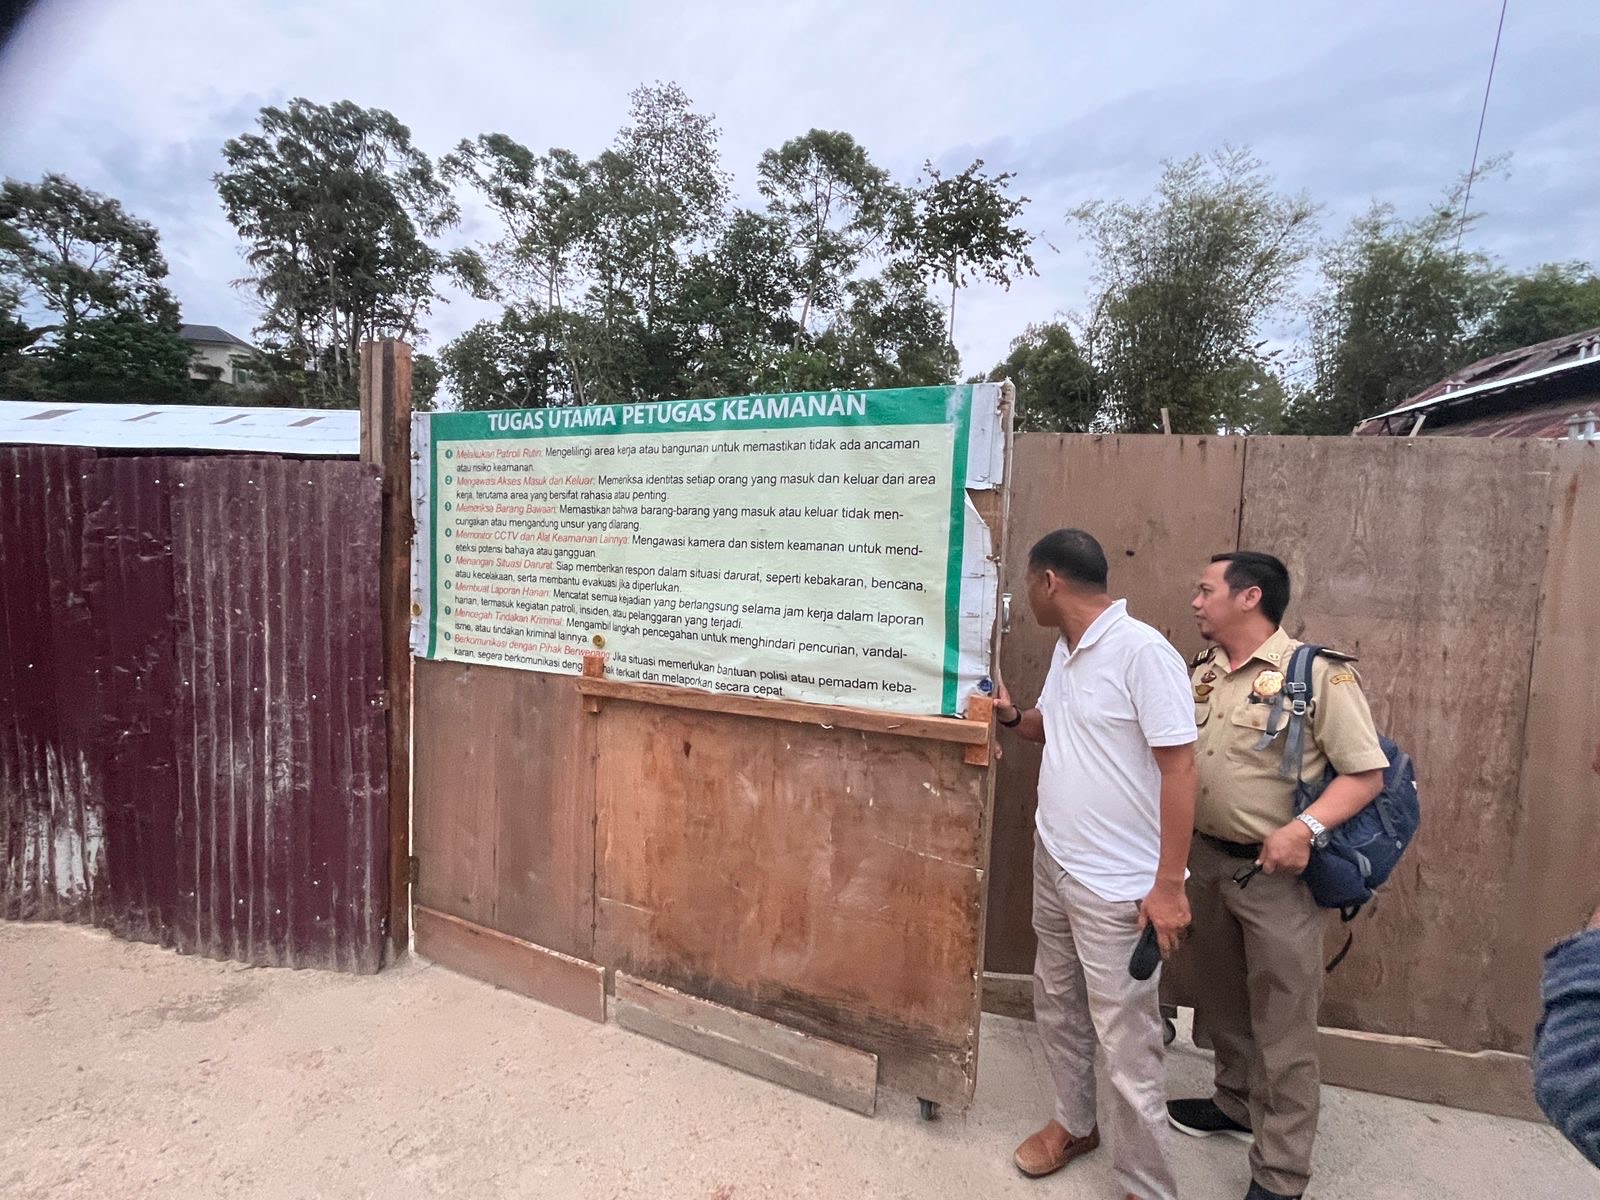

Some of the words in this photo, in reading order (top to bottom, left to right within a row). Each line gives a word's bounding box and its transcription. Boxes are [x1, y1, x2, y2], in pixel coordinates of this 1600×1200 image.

[488, 411, 544, 432] TUGAS
[548, 406, 616, 429] UTAMA
[622, 401, 716, 425] PETUGAS
[722, 394, 867, 421] KEAMANAN
[545, 446, 592, 458] Mengelilingi
[594, 447, 615, 456] area
[617, 445, 636, 457] kerja
[639, 445, 659, 454] atau
[661, 444, 709, 456] bangunan
[711, 442, 740, 452] untuk
[742, 440, 806, 452] memastikan
[809, 439, 836, 450] tidak
[839, 439, 861, 450] ada
[864, 440, 920, 450] ancaman
[456, 463, 472, 472] atau
[472, 463, 492, 472] risiko
[496, 475, 521, 486] Akses
[524, 475, 546, 485] Masuk
[549, 475, 564, 485] dan
[598, 475, 643, 485] Memeriksa
[645, 474, 684, 485] identitas
[686, 473, 715, 486] setiap
[718, 475, 748, 487] orang
[751, 475, 777, 487] yang
[780, 472, 815, 484] masuk
[817, 473, 840, 484] dan
[843, 473, 879, 485] keluar
[882, 473, 904, 485] dari
[908, 475, 936, 485] area
[476, 491, 509, 499] terutama
[530, 492, 548, 502] yang
[549, 490, 579, 500] bersifat
[580, 490, 613, 500] rahasia
[614, 490, 630, 499] atau
[495, 503, 525, 515] Barang
[559, 504, 611, 515] Memastikan
[612, 505, 638, 514] bahwa
[640, 504, 710, 518] barang-barang
[713, 507, 738, 519] yang
[741, 506, 776, 517] masuk
[778, 507, 801, 517] atau
[804, 506, 839, 517] keluar
[842, 507, 870, 519] tidak
[873, 510, 904, 520] men-
[490, 518, 507, 526] atau
[509, 518, 559, 530] mengandung
[560, 520, 584, 529] unsur
[587, 521, 607, 531] yang
[455, 544, 477, 553] eteksi
[478, 545, 503, 554] potensi
[505, 545, 534, 557] bahaya
[536, 546, 553, 555] atau
[494, 531, 519, 541] CCTV
[520, 532, 535, 541] dan
[536, 532, 551, 542] Alat
[552, 533, 598, 544] Keamanan
[632, 534, 686, 548] Mengawasi
[688, 536, 725, 548] kamera
[728, 537, 748, 549] dan
[750, 538, 784, 550] sistem
[788, 540, 844, 552] keamanan
[848, 543, 881, 554] untuk
[886, 545, 923, 556] mend-
[455, 569, 471, 579] atau
[517, 574, 537, 583] serta
[539, 574, 580, 586] membantu
[582, 577, 617, 588] evakuasi
[618, 579, 630, 591] jika
[496, 557, 522, 568] Situasi
[556, 560, 574, 573] Siap
[576, 563, 624, 574] memberikan
[625, 566, 655, 577] respon
[657, 566, 687, 578] dalam
[690, 568, 721, 579] situasi
[723, 570, 762, 583] darurat,
[765, 573, 801, 585] seperti
[804, 573, 867, 589] kebakaran,
[871, 577, 927, 593] bencana,
[455, 582, 489, 593] Membuat
[491, 584, 520, 596] Laporan
[553, 588, 589, 601] Mencatat
[591, 593, 618, 603] semua
[619, 594, 651, 606] kejadian
[653, 599, 676, 610] yang
[679, 598, 739, 615] berlangsung
[742, 603, 781, 616] selama
[783, 604, 804, 619] jam
[807, 607, 833, 622] kerja
[836, 609, 873, 622] dalam
[877, 612, 924, 627] laporan
[481, 598, 514, 609] termasuk
[516, 599, 549, 612] kegiatan
[550, 603, 578, 615] patroli,
[612, 609, 627, 619] atau
[628, 611, 682, 624] pelanggaran
[684, 616, 708, 629] yang
[710, 617, 744, 631] terjadi.
[454, 608, 493, 619] Mencegah
[495, 611, 528, 623] Tindakan
[566, 617, 611, 631] Mengambil
[612, 622, 640, 636] langkah
[642, 627, 698, 641] pencegahan
[701, 632, 727, 643] untuk
[730, 635, 796, 650] menghindari
[798, 641, 859, 657] pencurian,
[862, 647, 908, 659] vandal-
[475, 624, 491, 633] atau
[493, 625, 524, 636] tindakan
[526, 628, 556, 639] kriminal
[454, 633, 507, 648] Berkomunikasi
[508, 640, 537, 652] dengan
[540, 642, 562, 654] Pihak
[613, 652, 627, 662] Jika
[628, 655, 655, 666] situasi
[658, 658, 715, 673] memerlukan
[716, 663, 757, 678] bantuan
[760, 670, 787, 681] polisi
[790, 673, 815, 684] atau
[818, 677, 878, 690] pemadam
[882, 680, 916, 693] keba-
[477, 650, 503, 662] segera
[504, 653, 560, 668] berkomunikasi
[562, 659, 583, 673] deng
[616, 668, 640, 679] terkait
[642, 671, 660, 681] dan
[662, 673, 713, 689] melaporkan
[715, 681, 750, 693] secara
